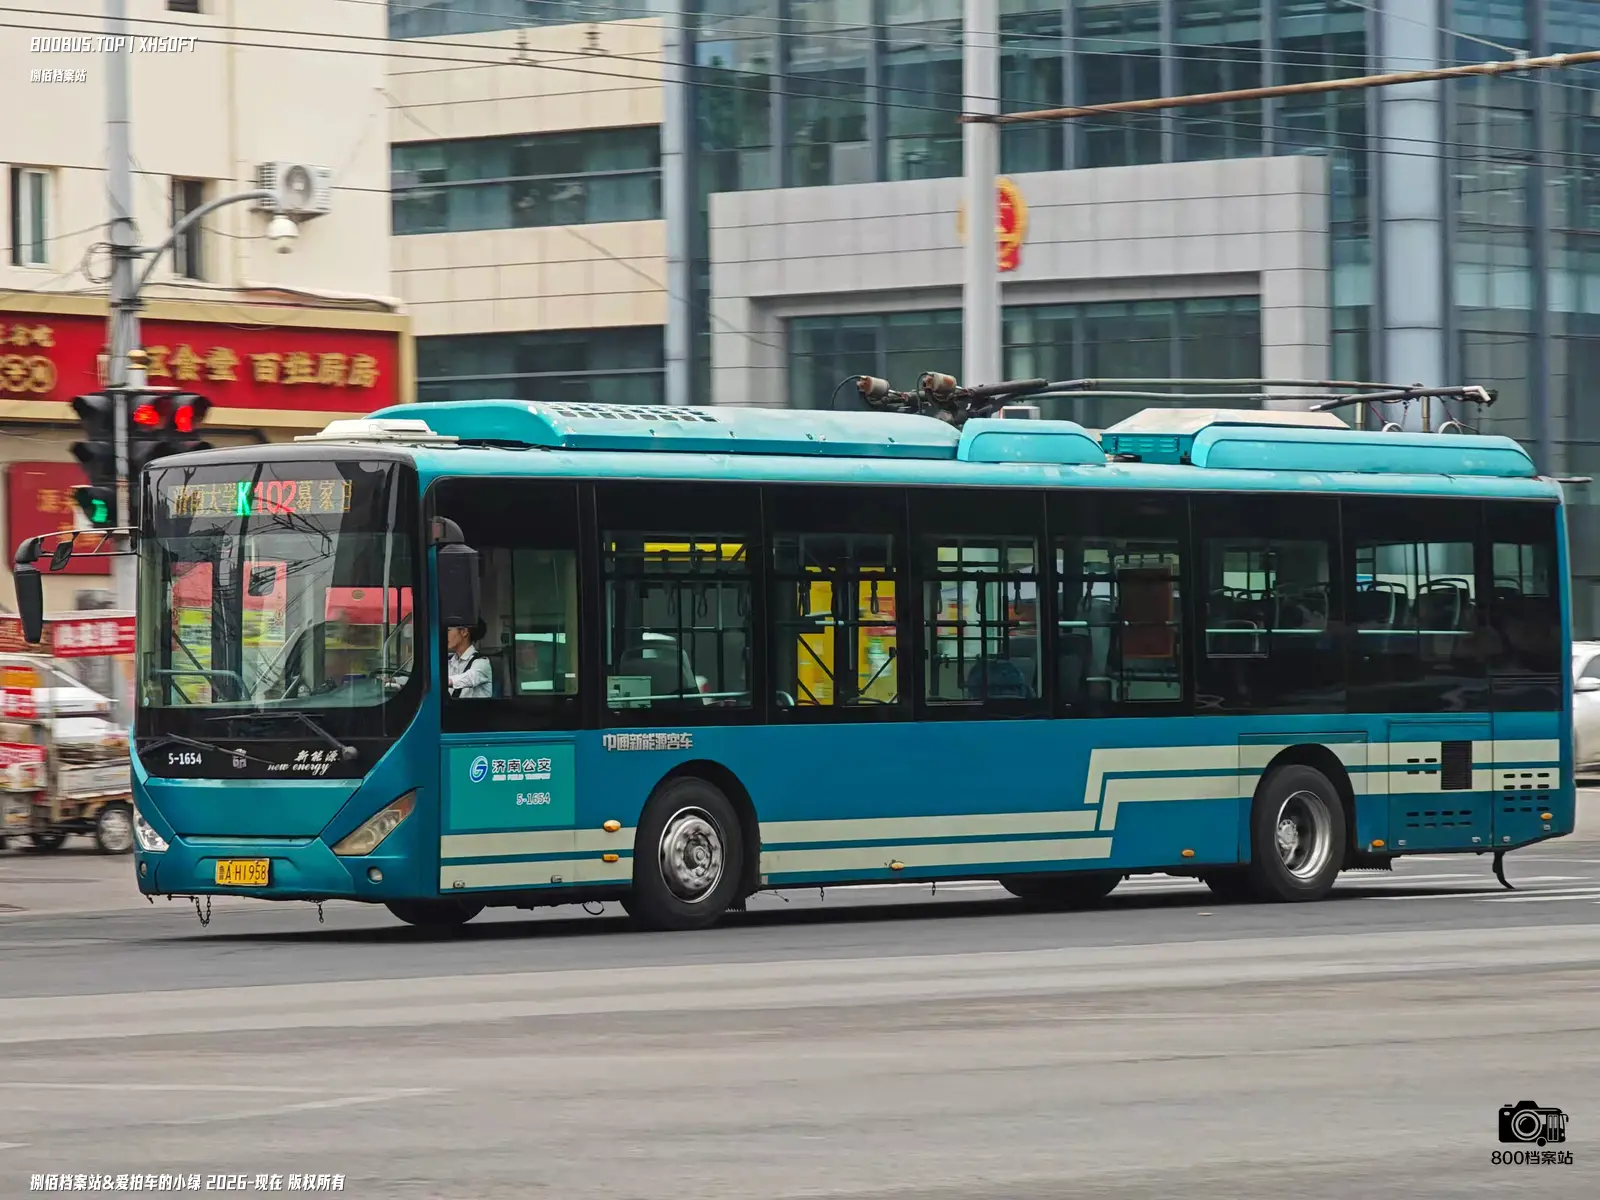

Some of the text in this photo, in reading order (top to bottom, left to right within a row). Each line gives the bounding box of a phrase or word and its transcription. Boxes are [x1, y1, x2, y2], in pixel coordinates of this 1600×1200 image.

[602, 732, 694, 752] 中通新能源客车
[168, 752, 202, 765] 5-1654
[294, 749, 339, 763] 新能源
[267, 763, 331, 776] new energy
[491, 758, 552, 773] 济南公交
[516, 792, 551, 806] 5-1654
